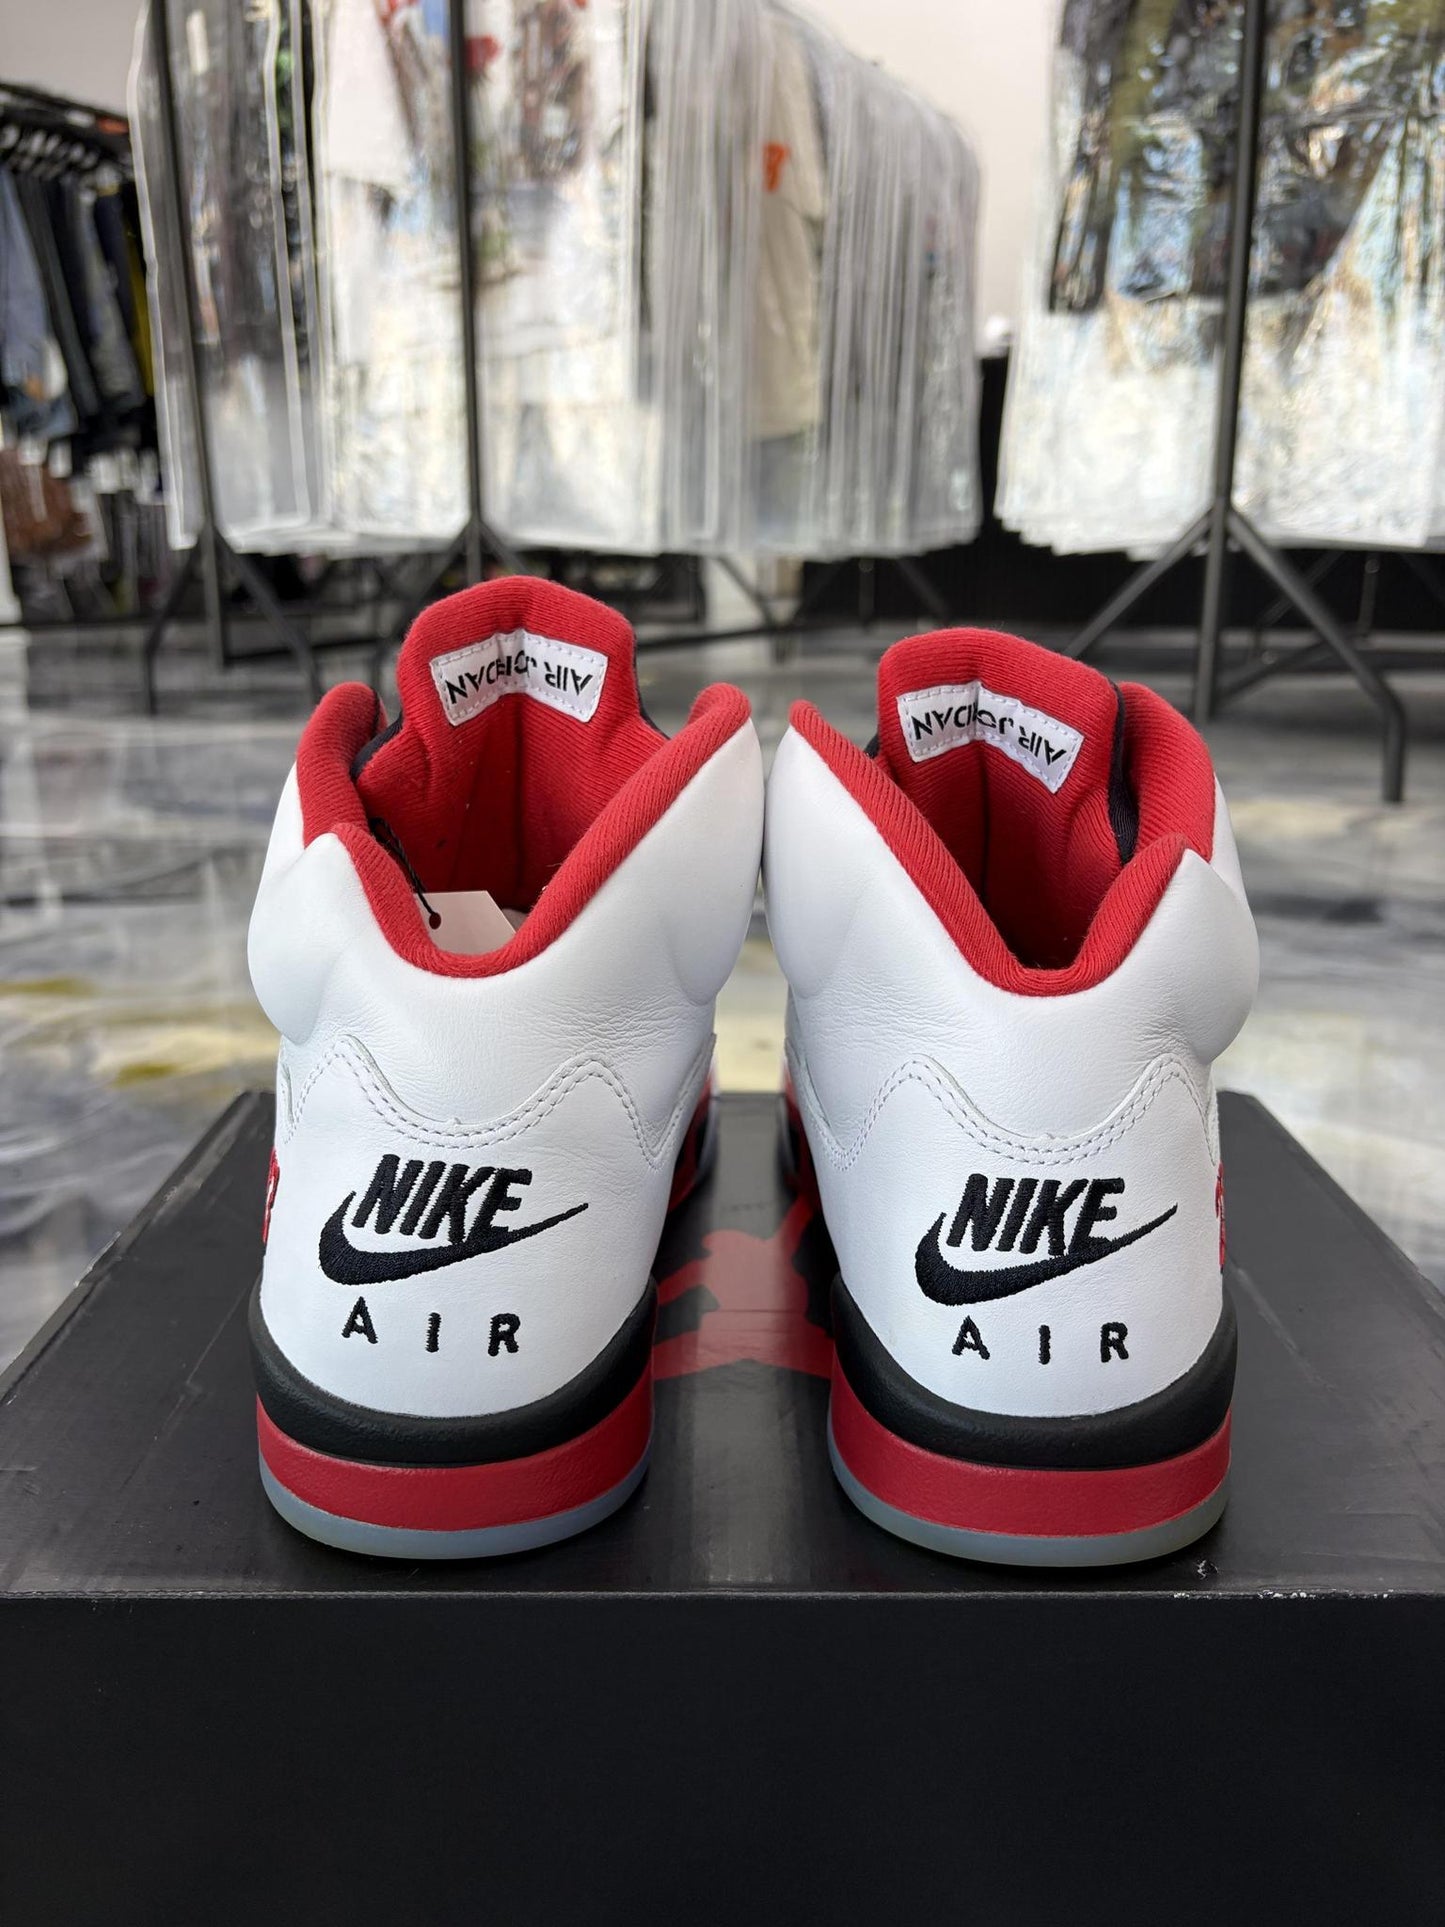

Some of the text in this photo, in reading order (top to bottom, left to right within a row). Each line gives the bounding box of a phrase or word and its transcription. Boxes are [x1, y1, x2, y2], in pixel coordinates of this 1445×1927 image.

[544, 662, 593, 696] AIR
[1018, 725, 1067, 766] AIR
[351, 1153, 533, 1243] NIKE
[946, 1173, 1125, 1255] NIKE
